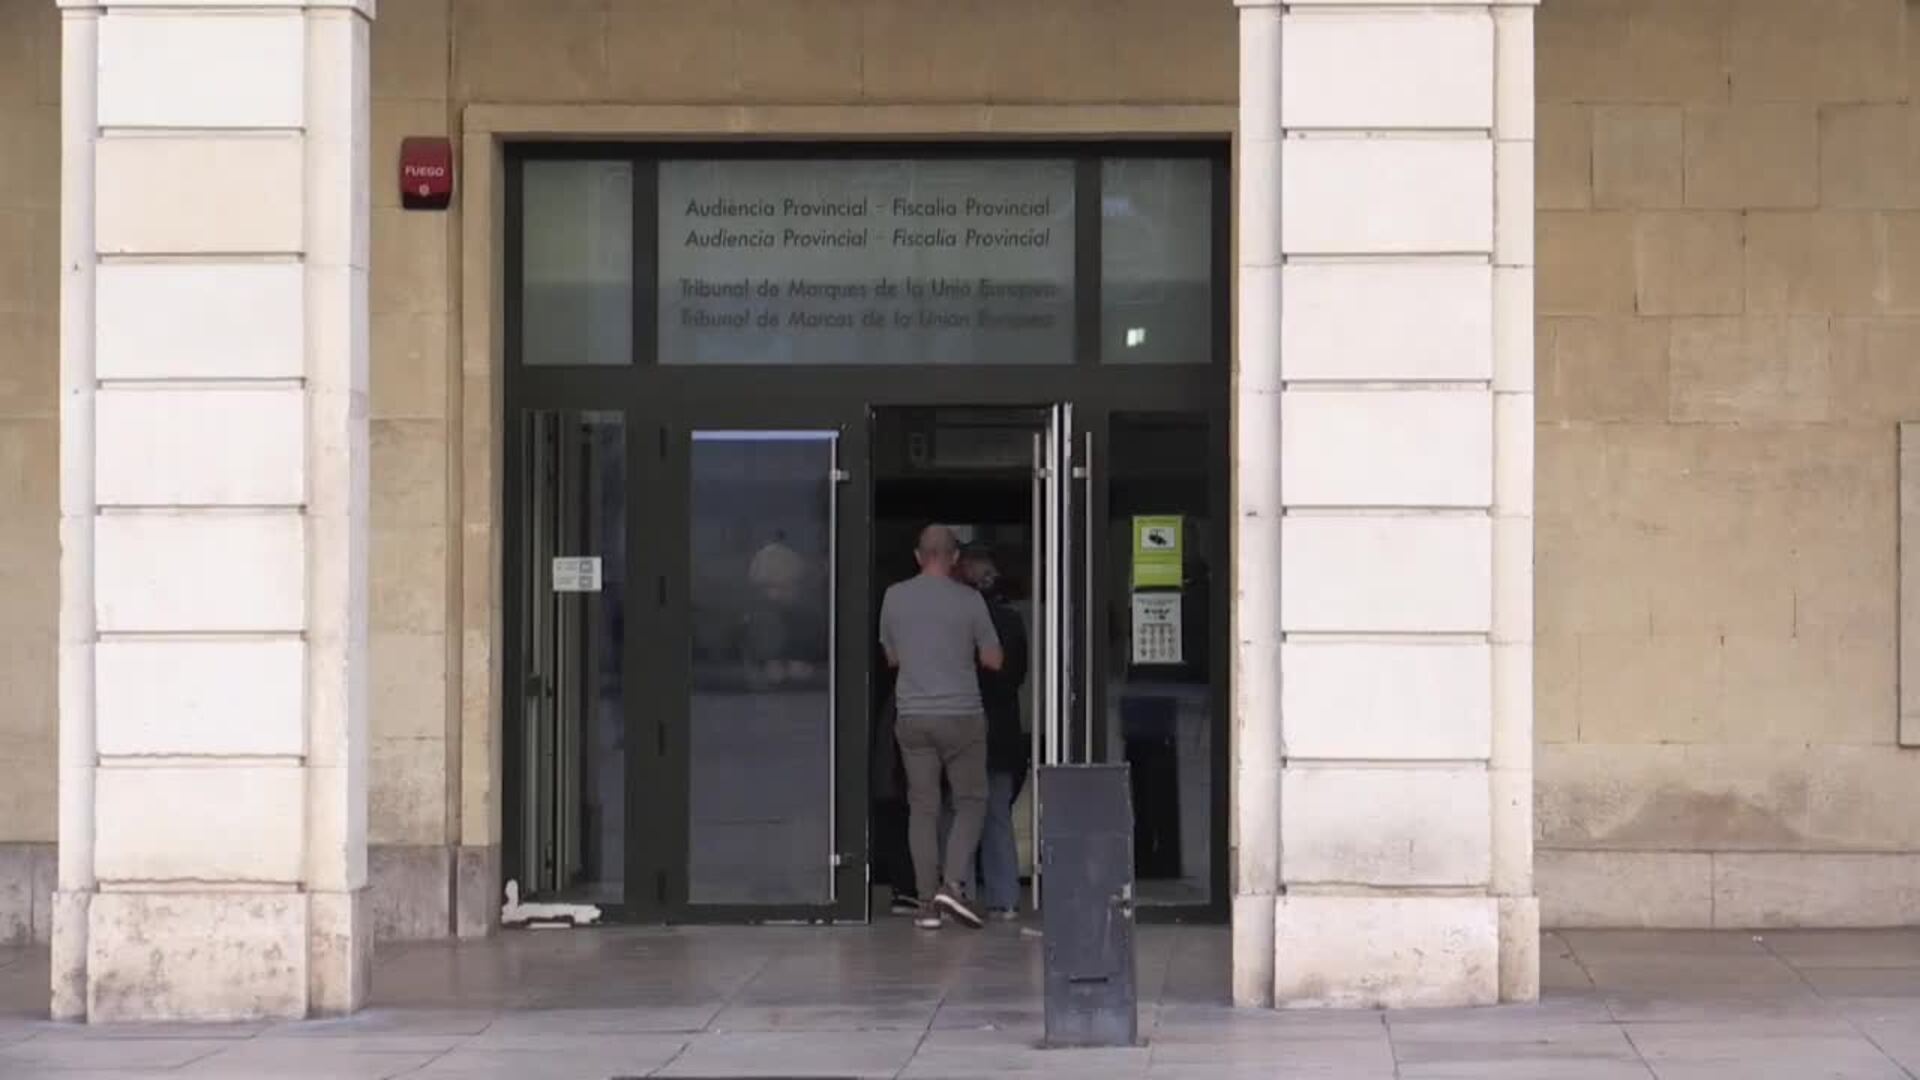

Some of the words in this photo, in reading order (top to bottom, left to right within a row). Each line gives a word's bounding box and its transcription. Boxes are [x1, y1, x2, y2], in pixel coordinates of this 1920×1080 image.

[405, 165, 444, 177] FUEGO
[685, 196, 775, 217] Audiencia
[783, 196, 868, 217] Provincial
[966, 196, 1050, 217] Provincial
[684, 228, 775, 247] Audiencia
[783, 228, 868, 247] Provincial
[965, 228, 1051, 247] Provincial
[680, 277, 750, 298] Tribunal
[756, 277, 780, 298] de
[787, 277, 867, 301] Marques
[875, 277, 898, 297] de
[905, 276, 924, 298] la
[681, 308, 751, 328] Tribunal
[756, 308, 780, 327] de
[787, 308, 853, 328] Marcas
[863, 308, 886, 327] de
